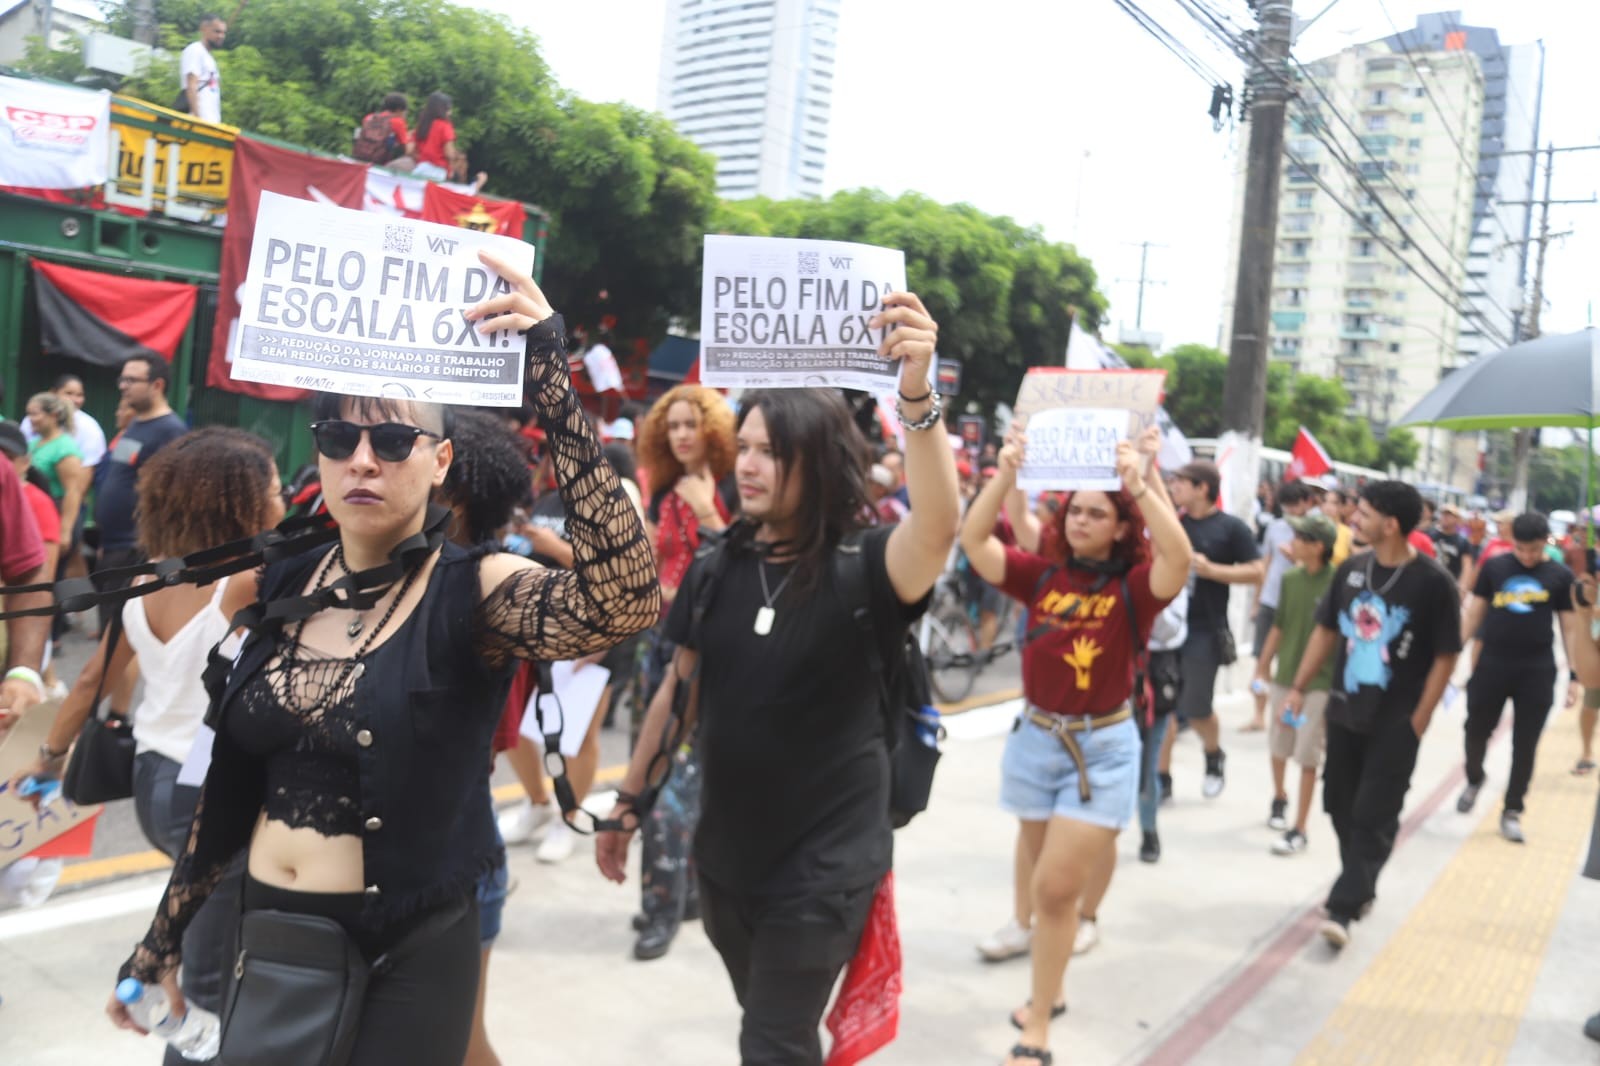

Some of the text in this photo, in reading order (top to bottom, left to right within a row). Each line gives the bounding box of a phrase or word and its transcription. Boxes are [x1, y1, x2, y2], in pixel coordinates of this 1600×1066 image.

[117, 140, 223, 186] junos
[426, 235, 459, 256] VAT
[264, 238, 512, 304] PELO FIM DA
[829, 256, 854, 270] VAT
[714, 276, 787, 309] PELO
[798, 278, 849, 311] FIM
[257, 283, 417, 343] ESCALA
[714, 312, 827, 345] ESCALA
[261, 346, 500, 379] SEM REDUÇÃO DE SALÁRIOS E DIREITOS!
[281, 337, 506, 367] REDUÇÃO DA JORNADA DE TRABALHO
[732, 351, 775, 360] REDUÇÃO
[791, 352, 833, 360] JORNADA
[740, 360, 783, 369] REDUÇÃO
